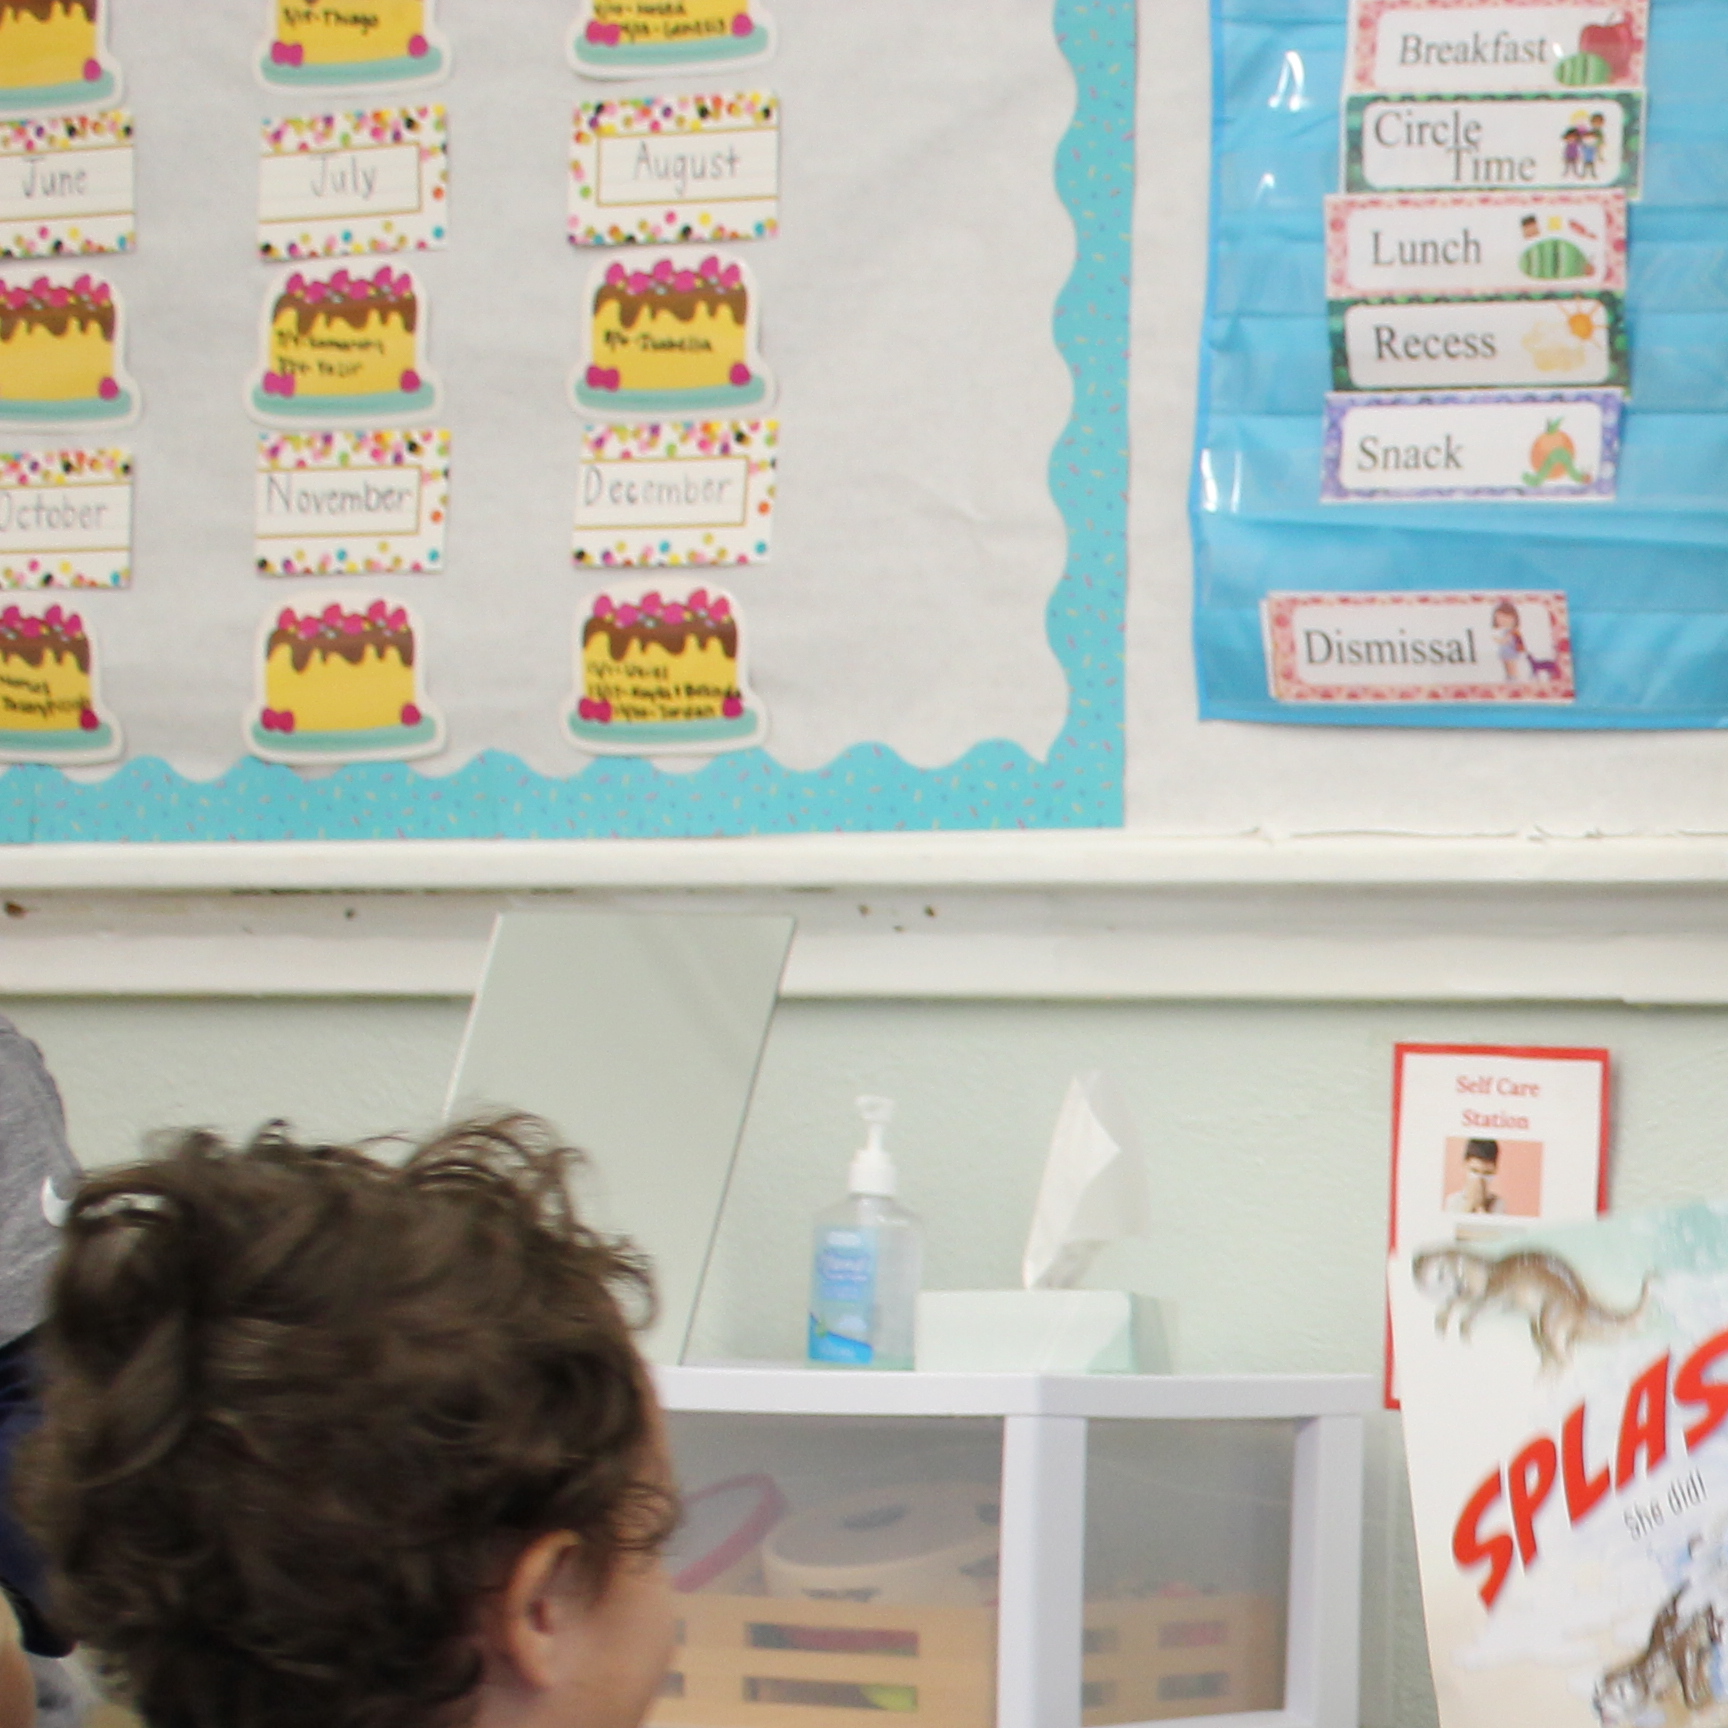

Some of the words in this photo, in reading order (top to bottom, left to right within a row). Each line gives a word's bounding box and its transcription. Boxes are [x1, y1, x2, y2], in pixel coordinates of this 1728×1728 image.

[1400, 31, 1548, 65] Breakfast
[1375, 109, 1482, 147] Circle
[22, 156, 86, 198] June
[310, 152, 377, 201] July
[633, 141, 742, 197] August
[1447, 146, 1537, 183] Time
[1371, 231, 1483, 267] Lunch
[1374, 325, 1498, 361] Recess
[1356, 436, 1464, 471] Snack
[267, 473, 411, 516] November
[584, 465, 732, 506] December
[1304, 630, 1478, 666] Dismissal
[1456, 1075, 1493, 1095] Self
[1496, 1077, 1541, 1098] Care
[1462, 1109, 1530, 1130] Station
